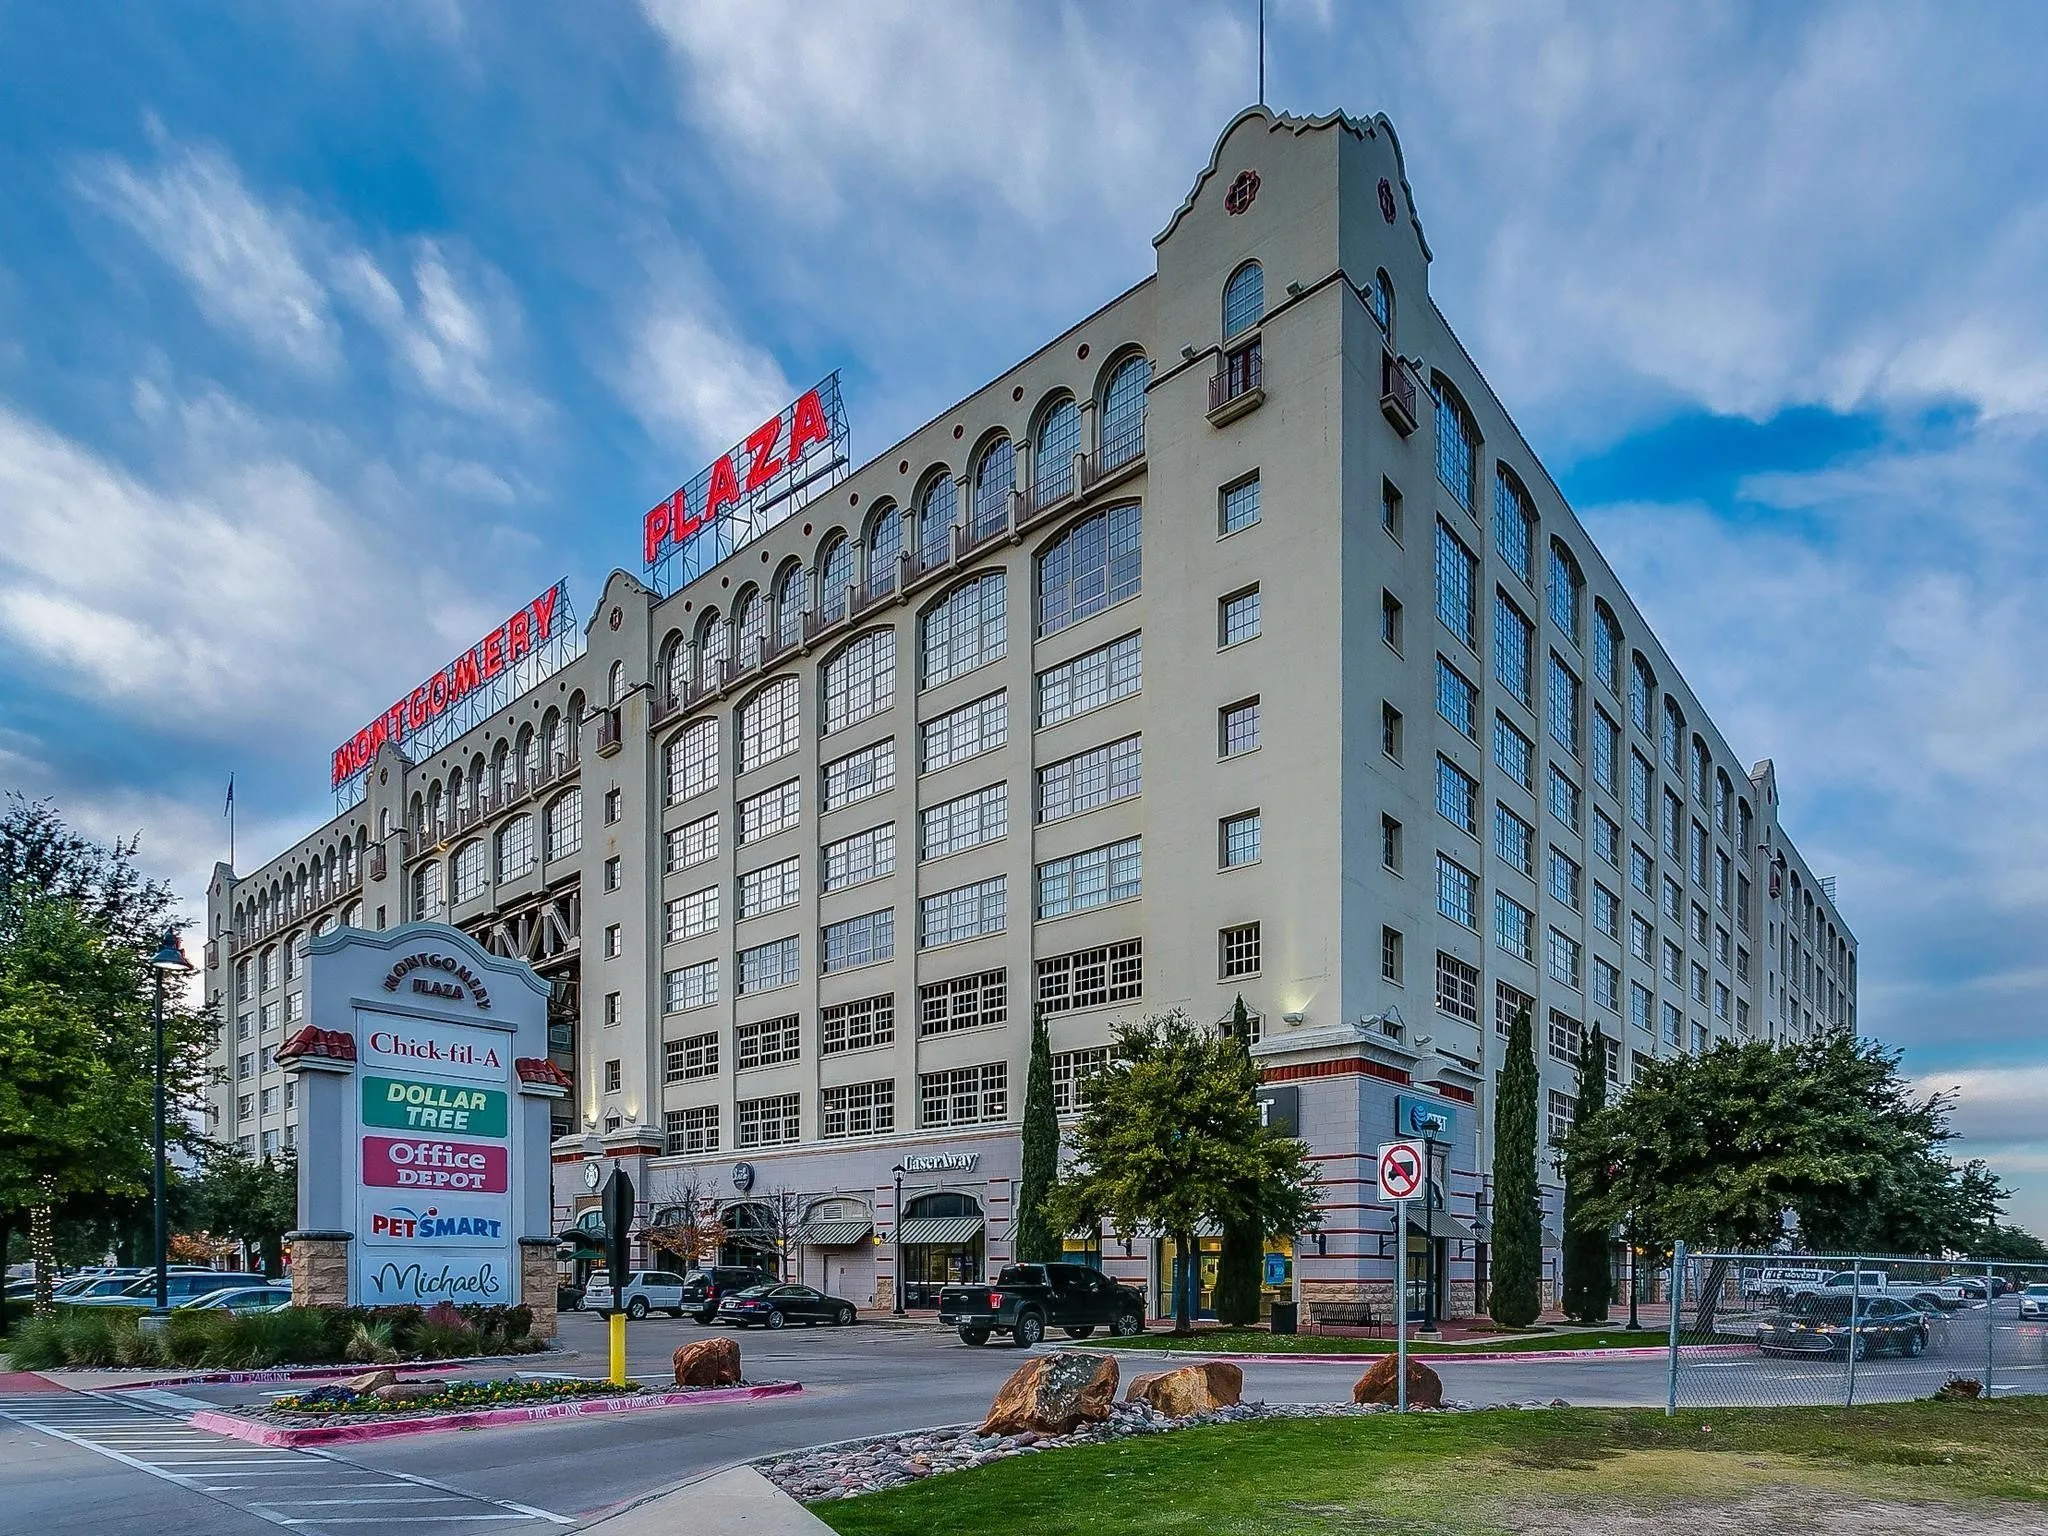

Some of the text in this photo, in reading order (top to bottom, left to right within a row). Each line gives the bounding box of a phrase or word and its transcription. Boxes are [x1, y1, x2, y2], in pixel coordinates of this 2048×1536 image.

[644, 388, 830, 564] PLAZA
[332, 585, 559, 784] MONTGOMERY
[382, 952, 493, 1010] MONTGOMERY
[412, 978, 465, 1000] PLAZA
[370, 1031, 502, 1069] Chick-fil-A
[387, 1083, 487, 1110] DOLLAR
[406, 1106, 470, 1130] TREE
[388, 1143, 486, 1169] Office
[396, 1168, 486, 1189] DEPOT
[370, 1262, 500, 1299] Michaels
[229, 1372, 291, 1383] NO PARKING
[527, 1403, 585, 1420] FIRE LANE
[606, 1396, 666, 1411] NO PARKING
